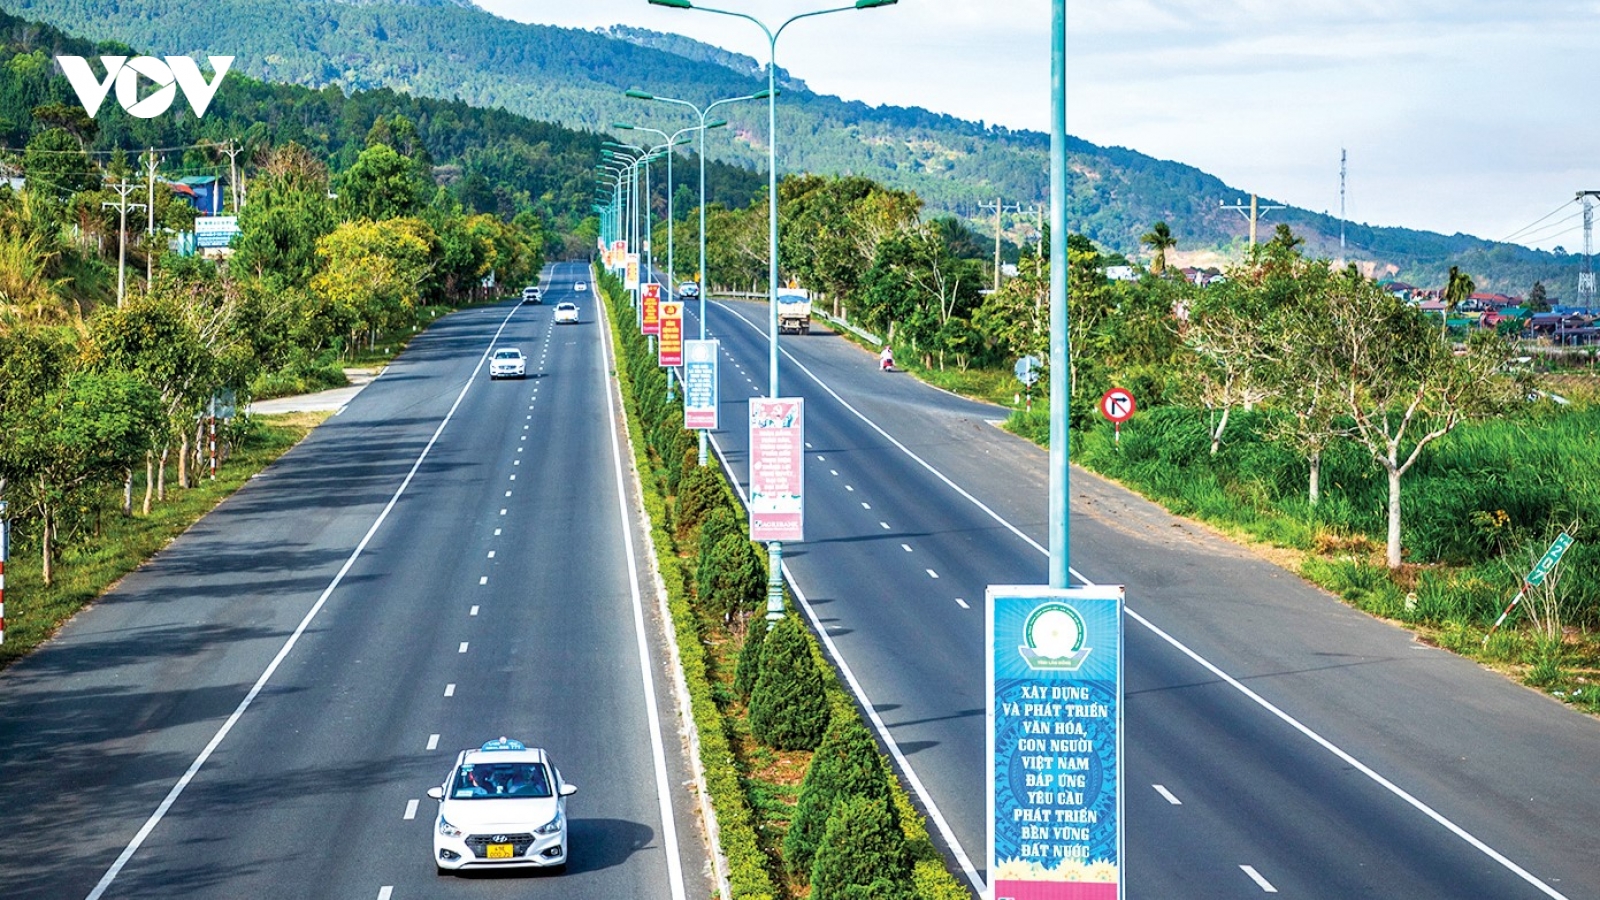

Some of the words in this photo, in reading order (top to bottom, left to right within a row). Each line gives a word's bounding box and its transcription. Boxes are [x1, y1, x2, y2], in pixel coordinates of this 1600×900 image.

[1021, 685, 1048, 699] XÂY
[1051, 686, 1089, 701] DỰNG
[1002, 701, 1021, 717] VÀ
[1024, 702, 1062, 717] PHÁT
[1064, 702, 1108, 718] TRIỂN
[1022, 720, 1050, 734] VĂN
[1054, 720, 1088, 738] HÓA,
[1018, 739, 1046, 752] CON
[1050, 738, 1093, 753] NGƯỜI
[1021, 755, 1054, 771] VIỆT
[1057, 757, 1089, 770] NAM
[1025, 772, 1053, 787] ĐÁP
[1057, 773, 1085, 788] ỨNG
[1027, 790, 1053, 804] YÊU
[1057, 789, 1083, 805] CẦU
[1013, 807, 1051, 822] PHÁT
[1054, 807, 1097, 823] TRIỂN
[1021, 824, 1049, 840] BỀN
[1053, 825, 1089, 841] VỮNG
[1021, 842, 1049, 857] ĐẤT
[1053, 843, 1089, 858] NƯỚC
